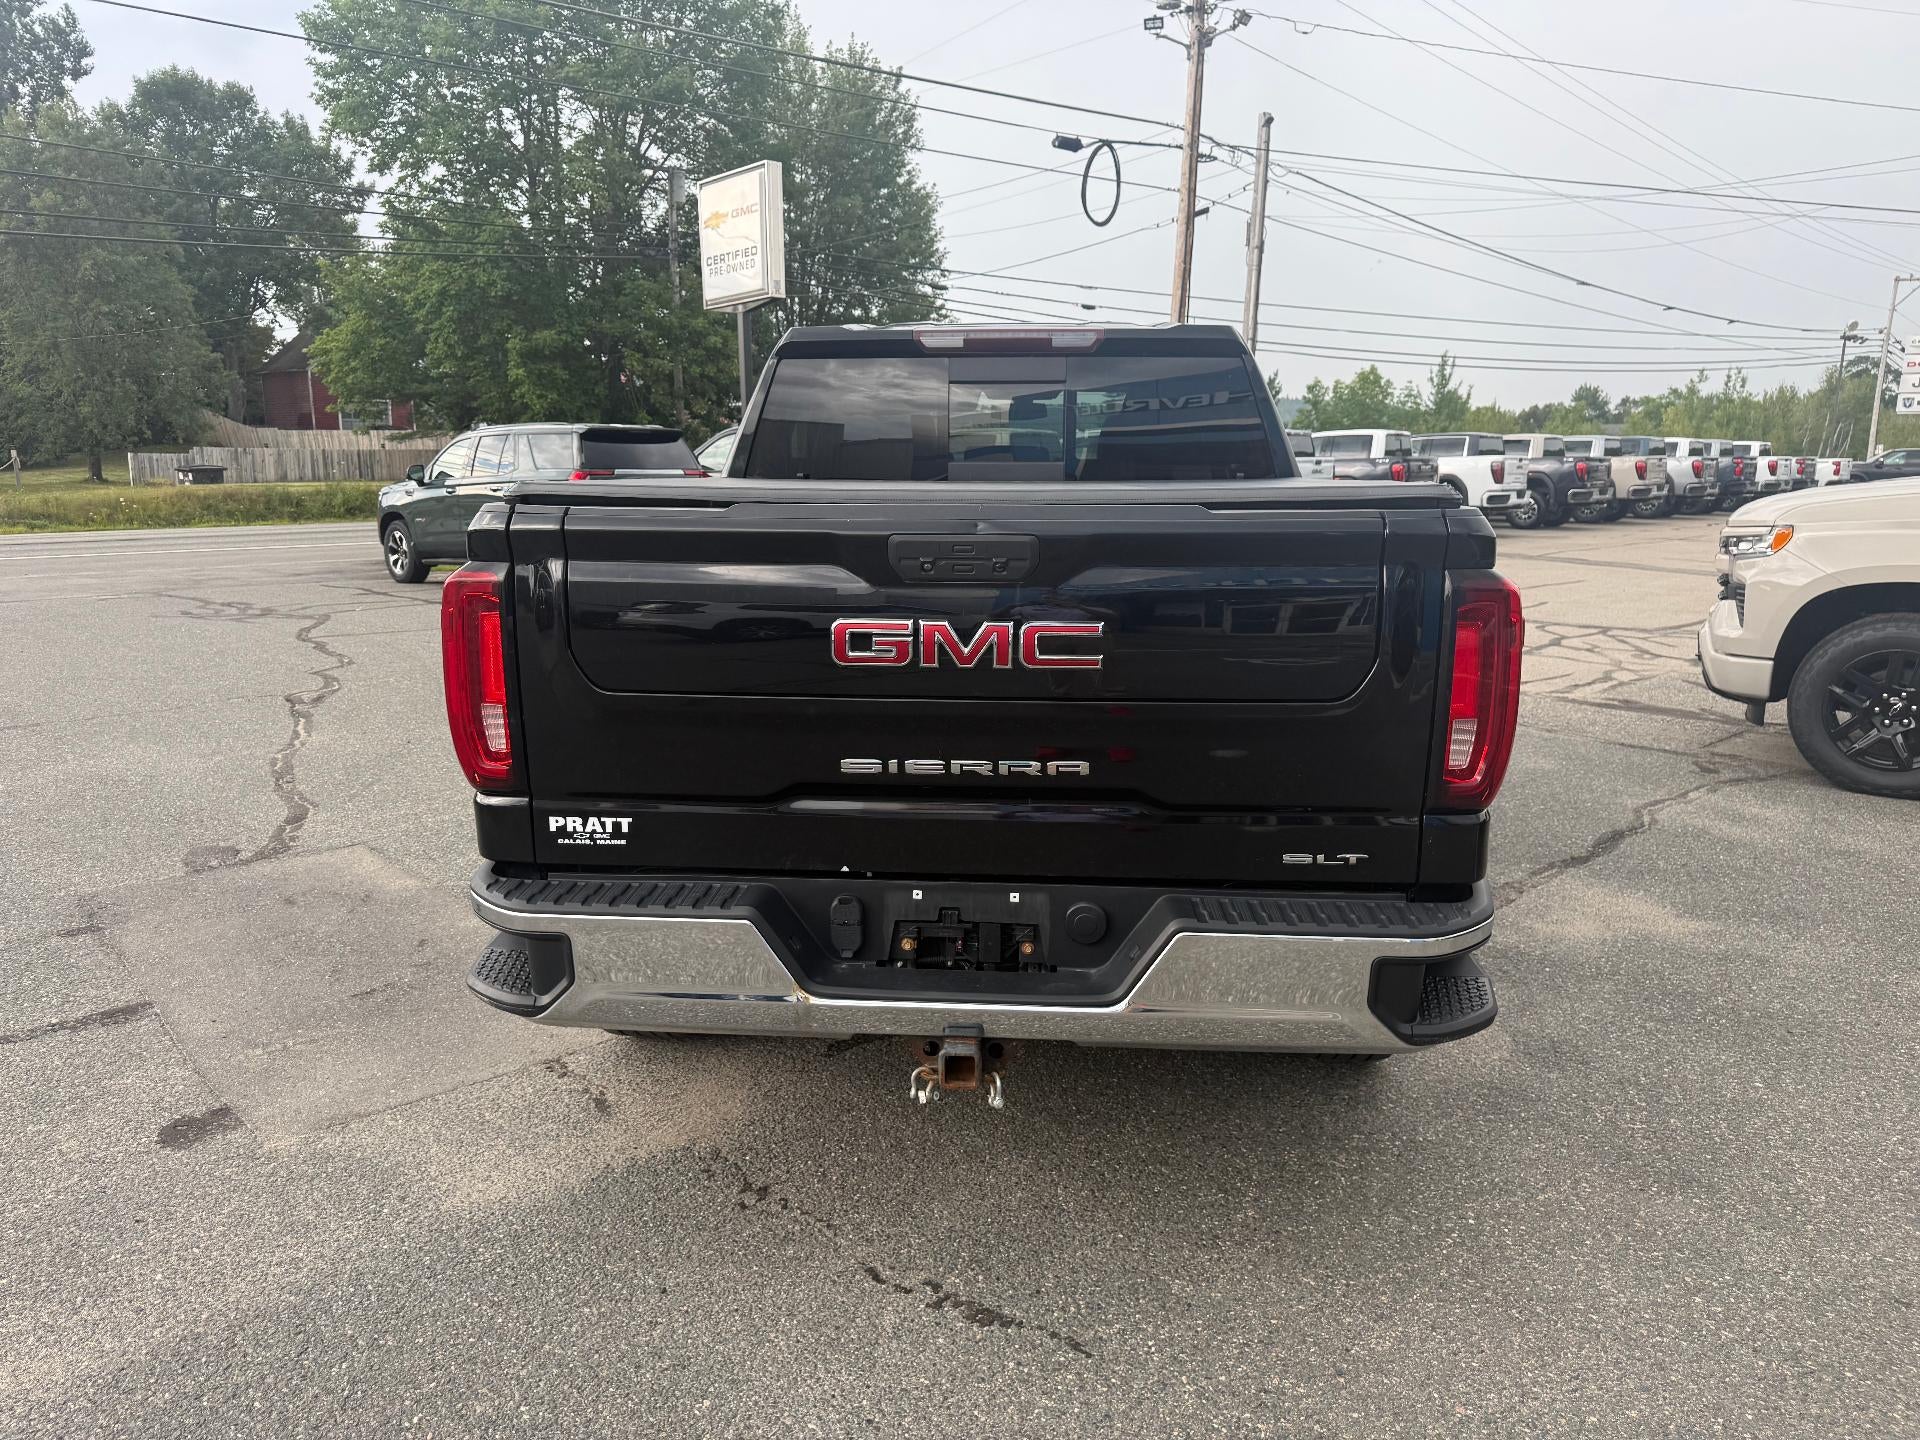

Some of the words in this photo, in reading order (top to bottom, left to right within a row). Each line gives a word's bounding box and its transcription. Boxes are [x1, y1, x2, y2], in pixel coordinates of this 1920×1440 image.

[730, 203, 760, 218] GMC
[706, 245, 758, 267] CERTIFIED
[708, 258, 756, 278] PRE-OWNED
[831, 618, 1105, 670] GMC
[840, 758, 1091, 776] SIERRA
[548, 816, 633, 833] PRATT
[1282, 853, 1369, 865] SLT
